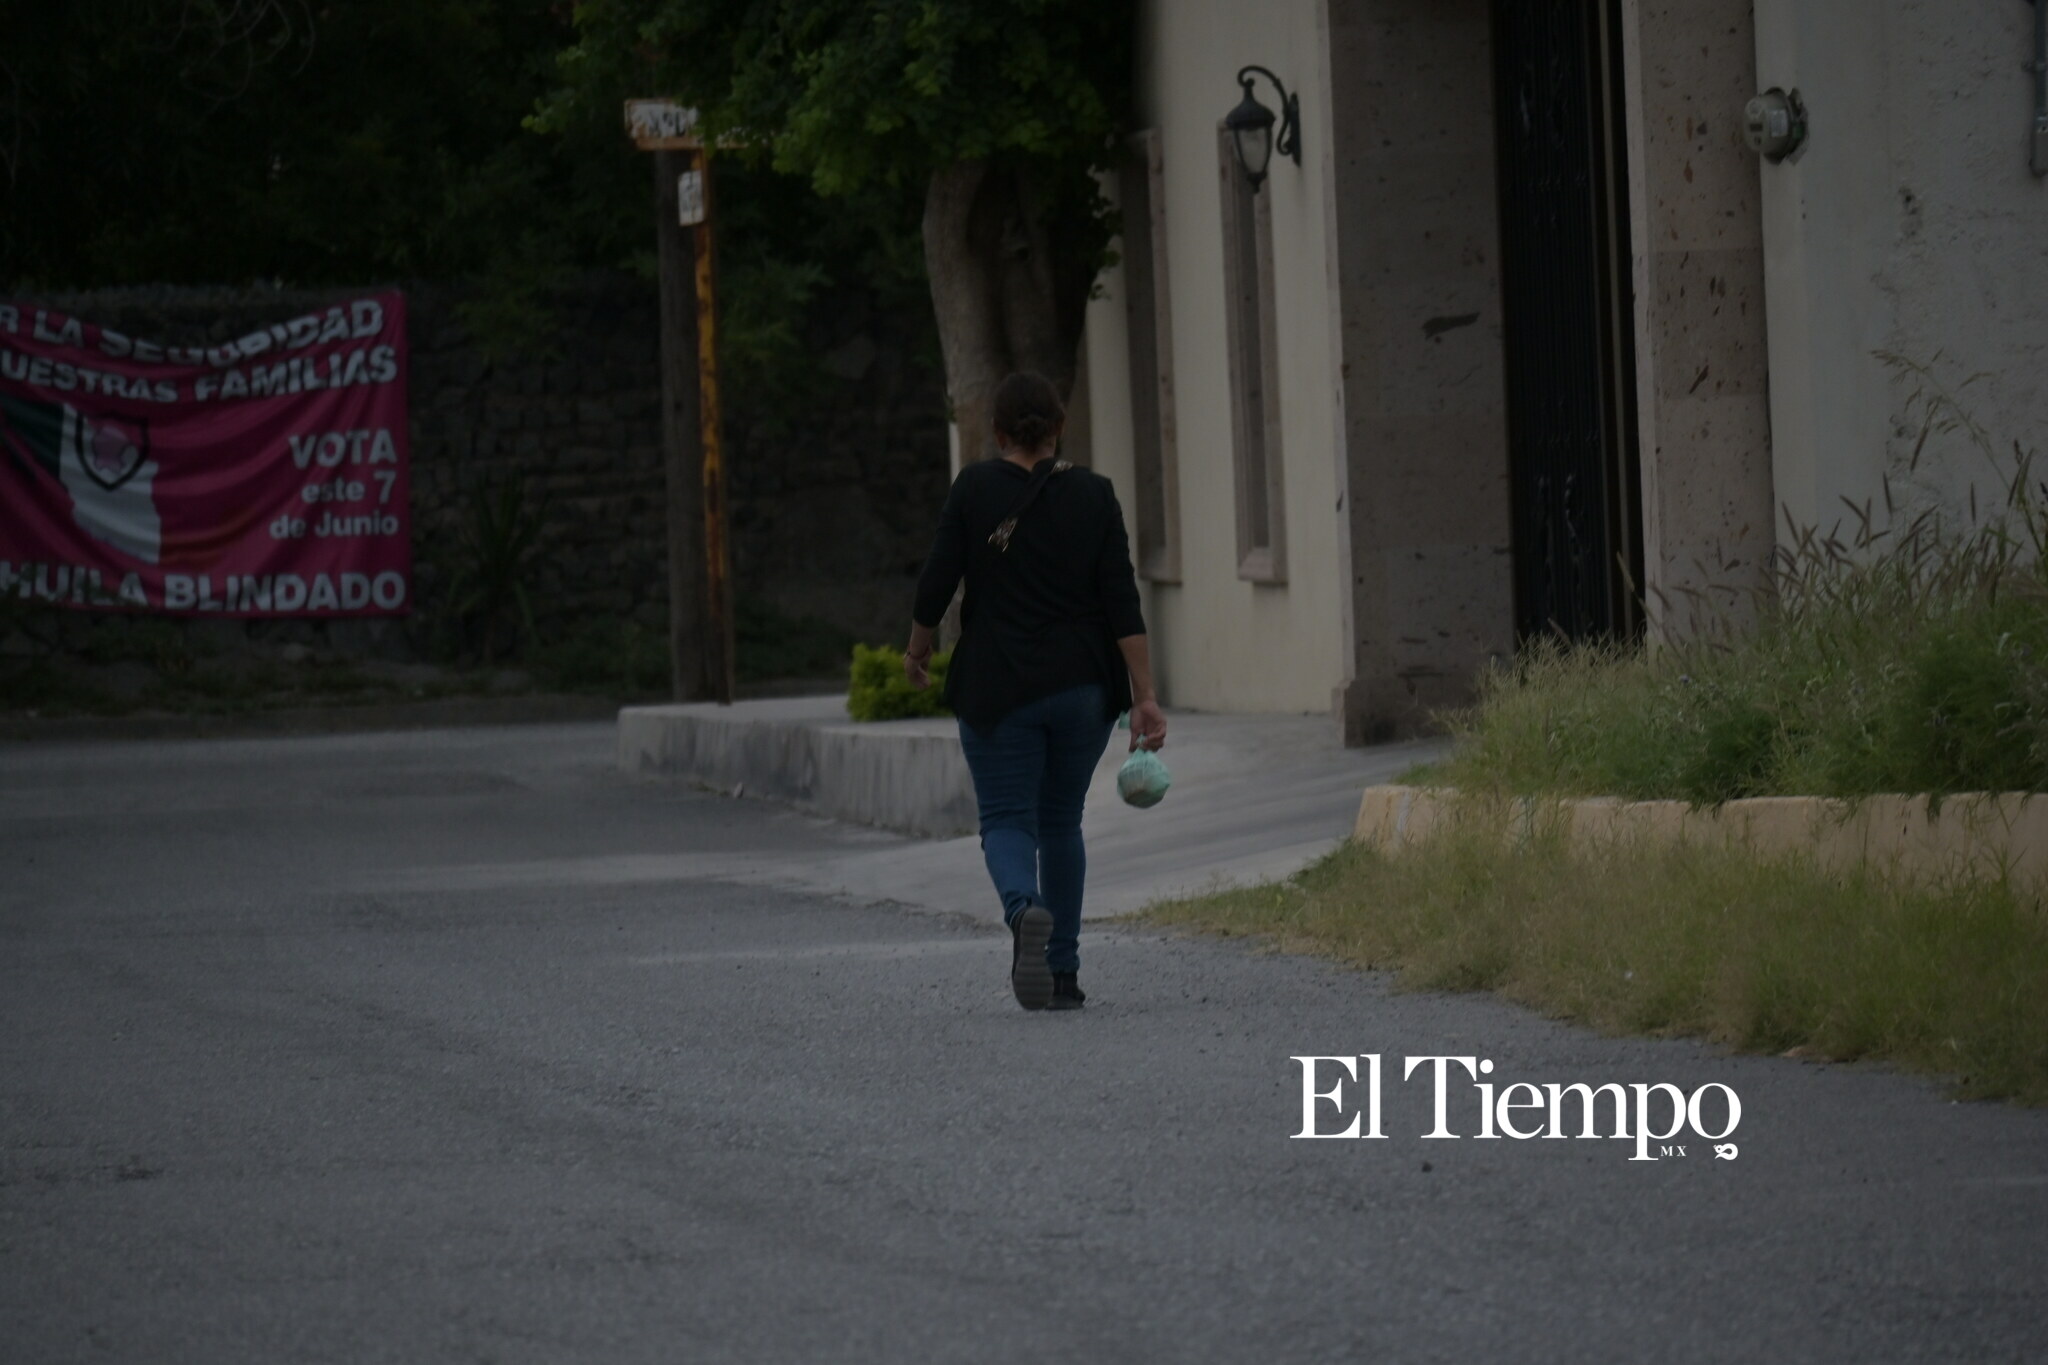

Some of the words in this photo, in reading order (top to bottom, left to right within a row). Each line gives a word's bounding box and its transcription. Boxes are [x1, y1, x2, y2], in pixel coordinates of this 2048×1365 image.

[33, 309, 84, 348] LA
[1, 349, 178, 403] UESTRAS
[195, 344, 398, 402] FAMILIAS
[288, 428, 398, 470] VOTA
[301, 479, 365, 504] este
[374, 470, 397, 504] 7
[269, 513, 307, 539] de
[314, 513, 399, 539] Junio
[164, 571, 407, 612] BLINDADO
